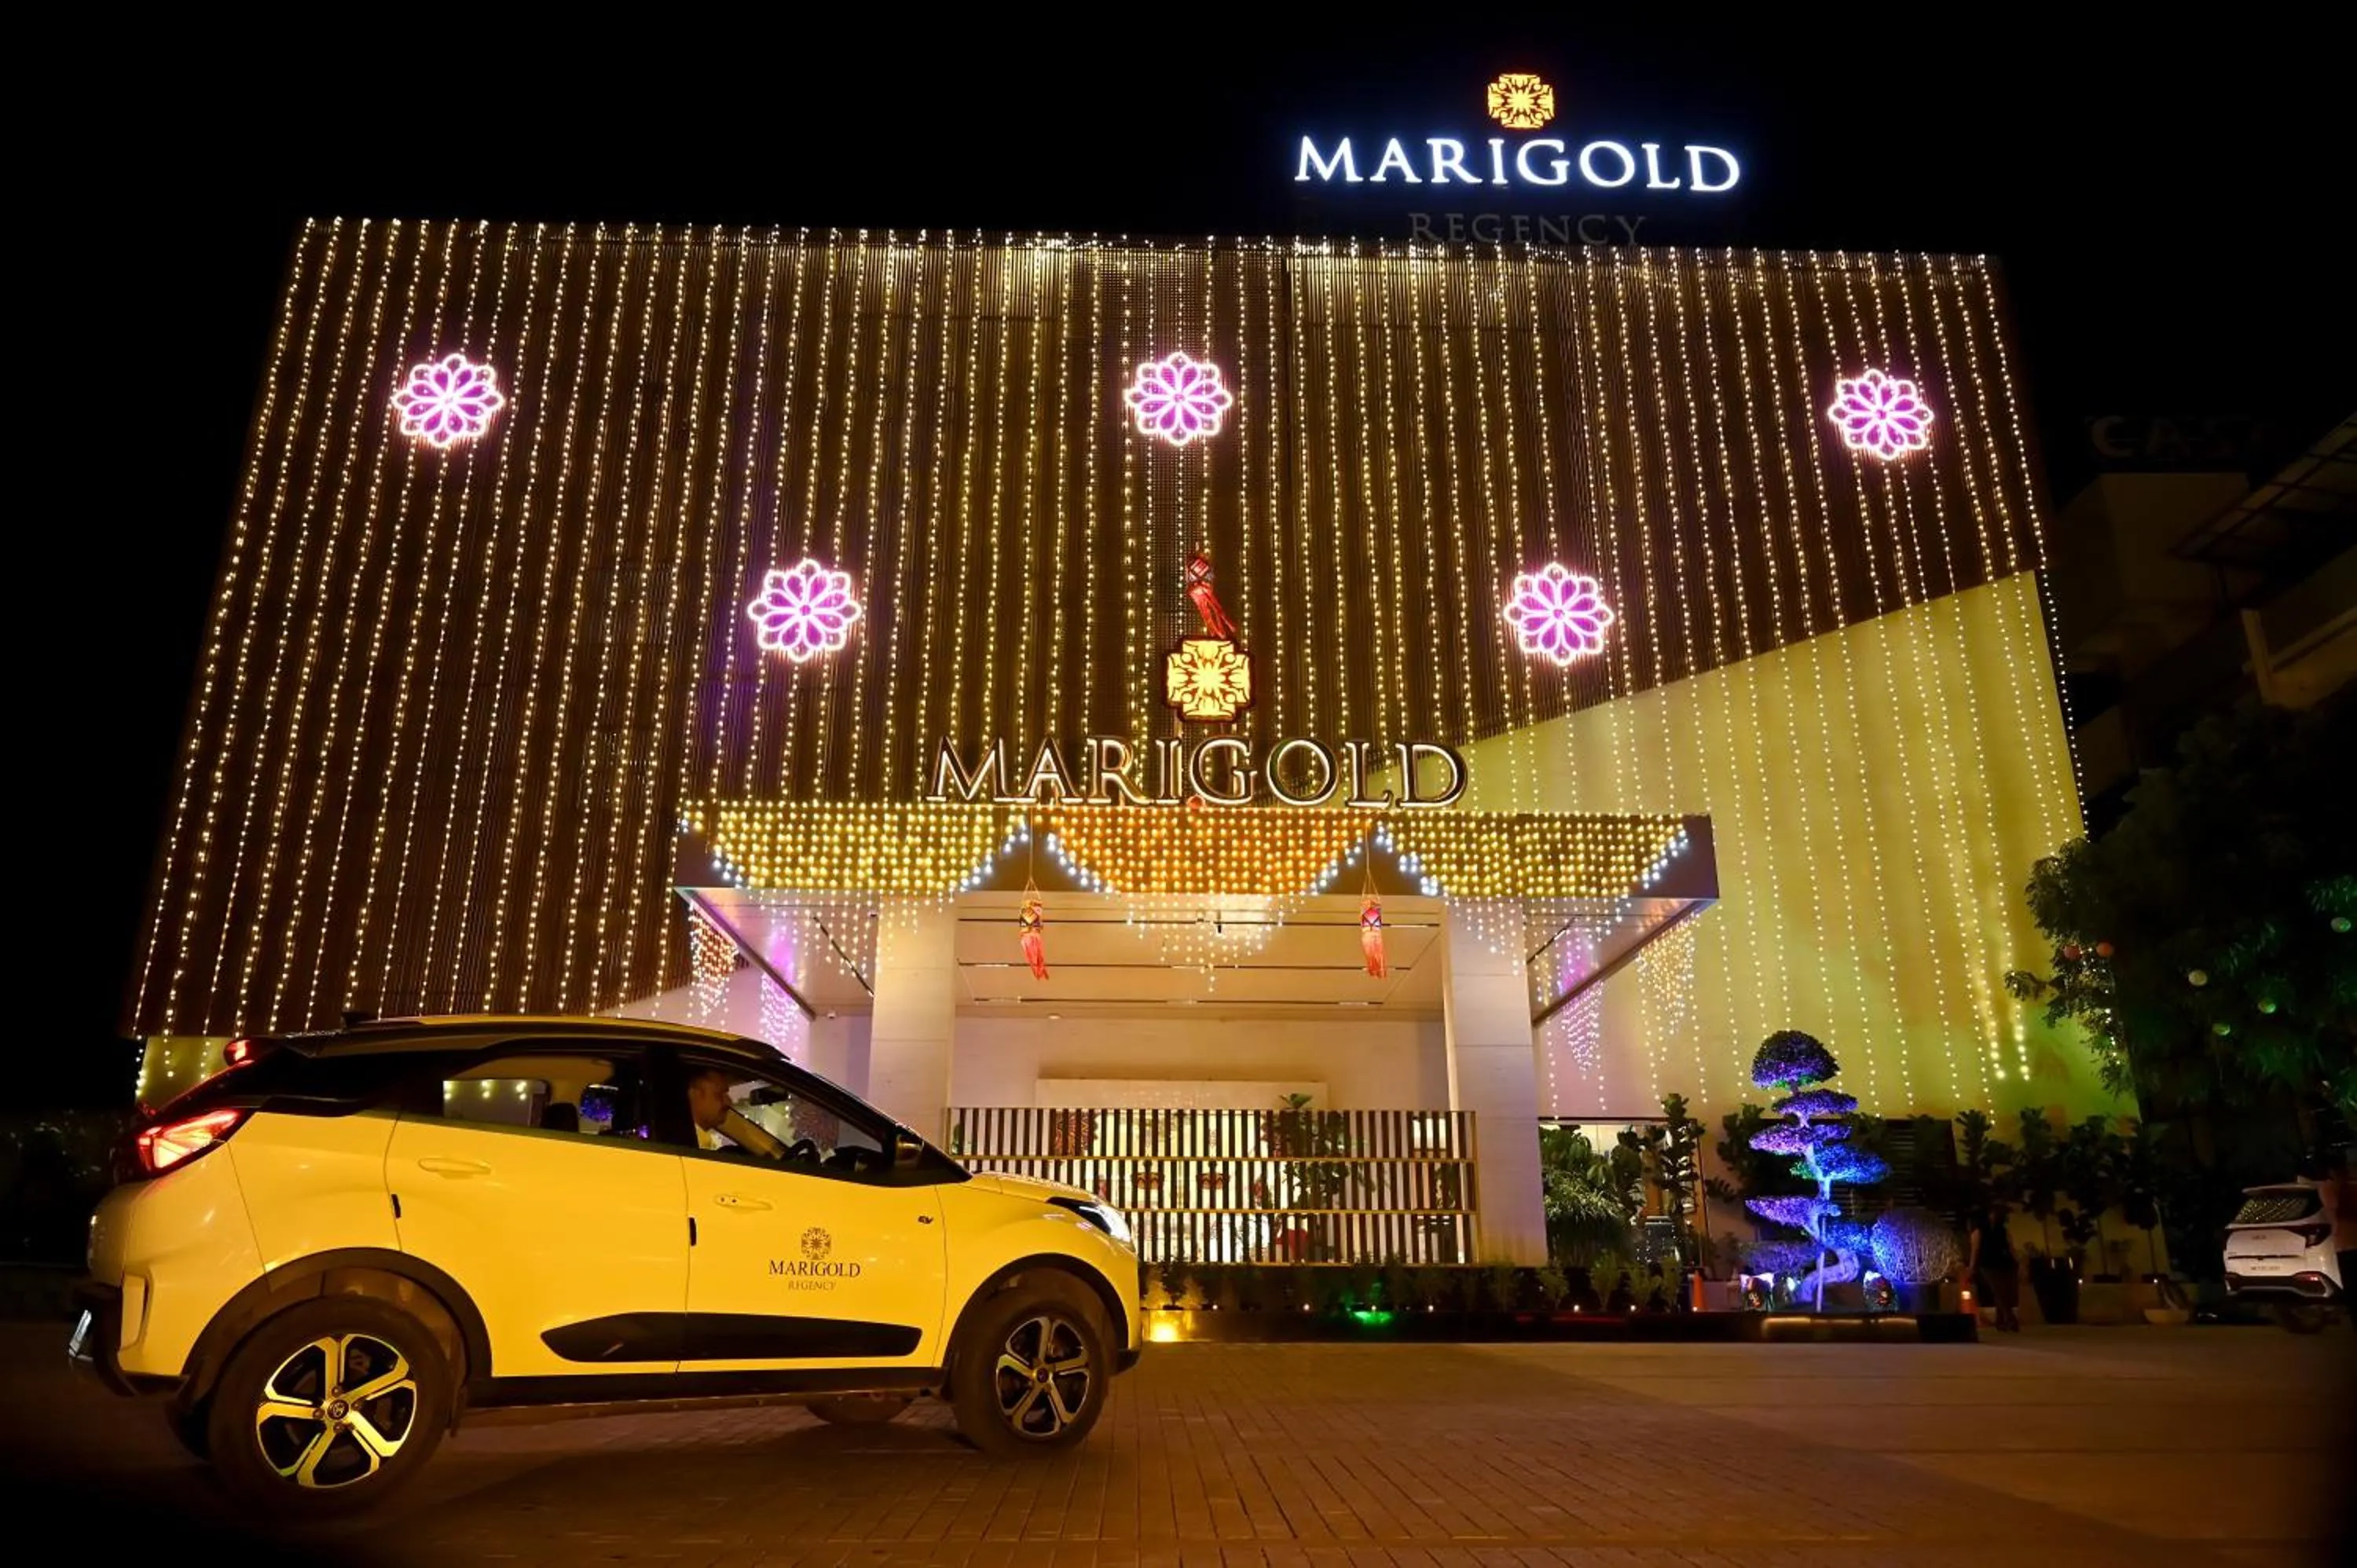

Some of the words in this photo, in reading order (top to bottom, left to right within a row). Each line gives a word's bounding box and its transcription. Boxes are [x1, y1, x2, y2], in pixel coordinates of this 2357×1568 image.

[1295, 136, 1741, 192] MARIGOLD
[1408, 212, 1648, 246] REGENCY
[926, 734, 1468, 809] MARIGOLD
[768, 1259, 861, 1277] MARIGOLD
[788, 1280, 836, 1291] REGENCY
